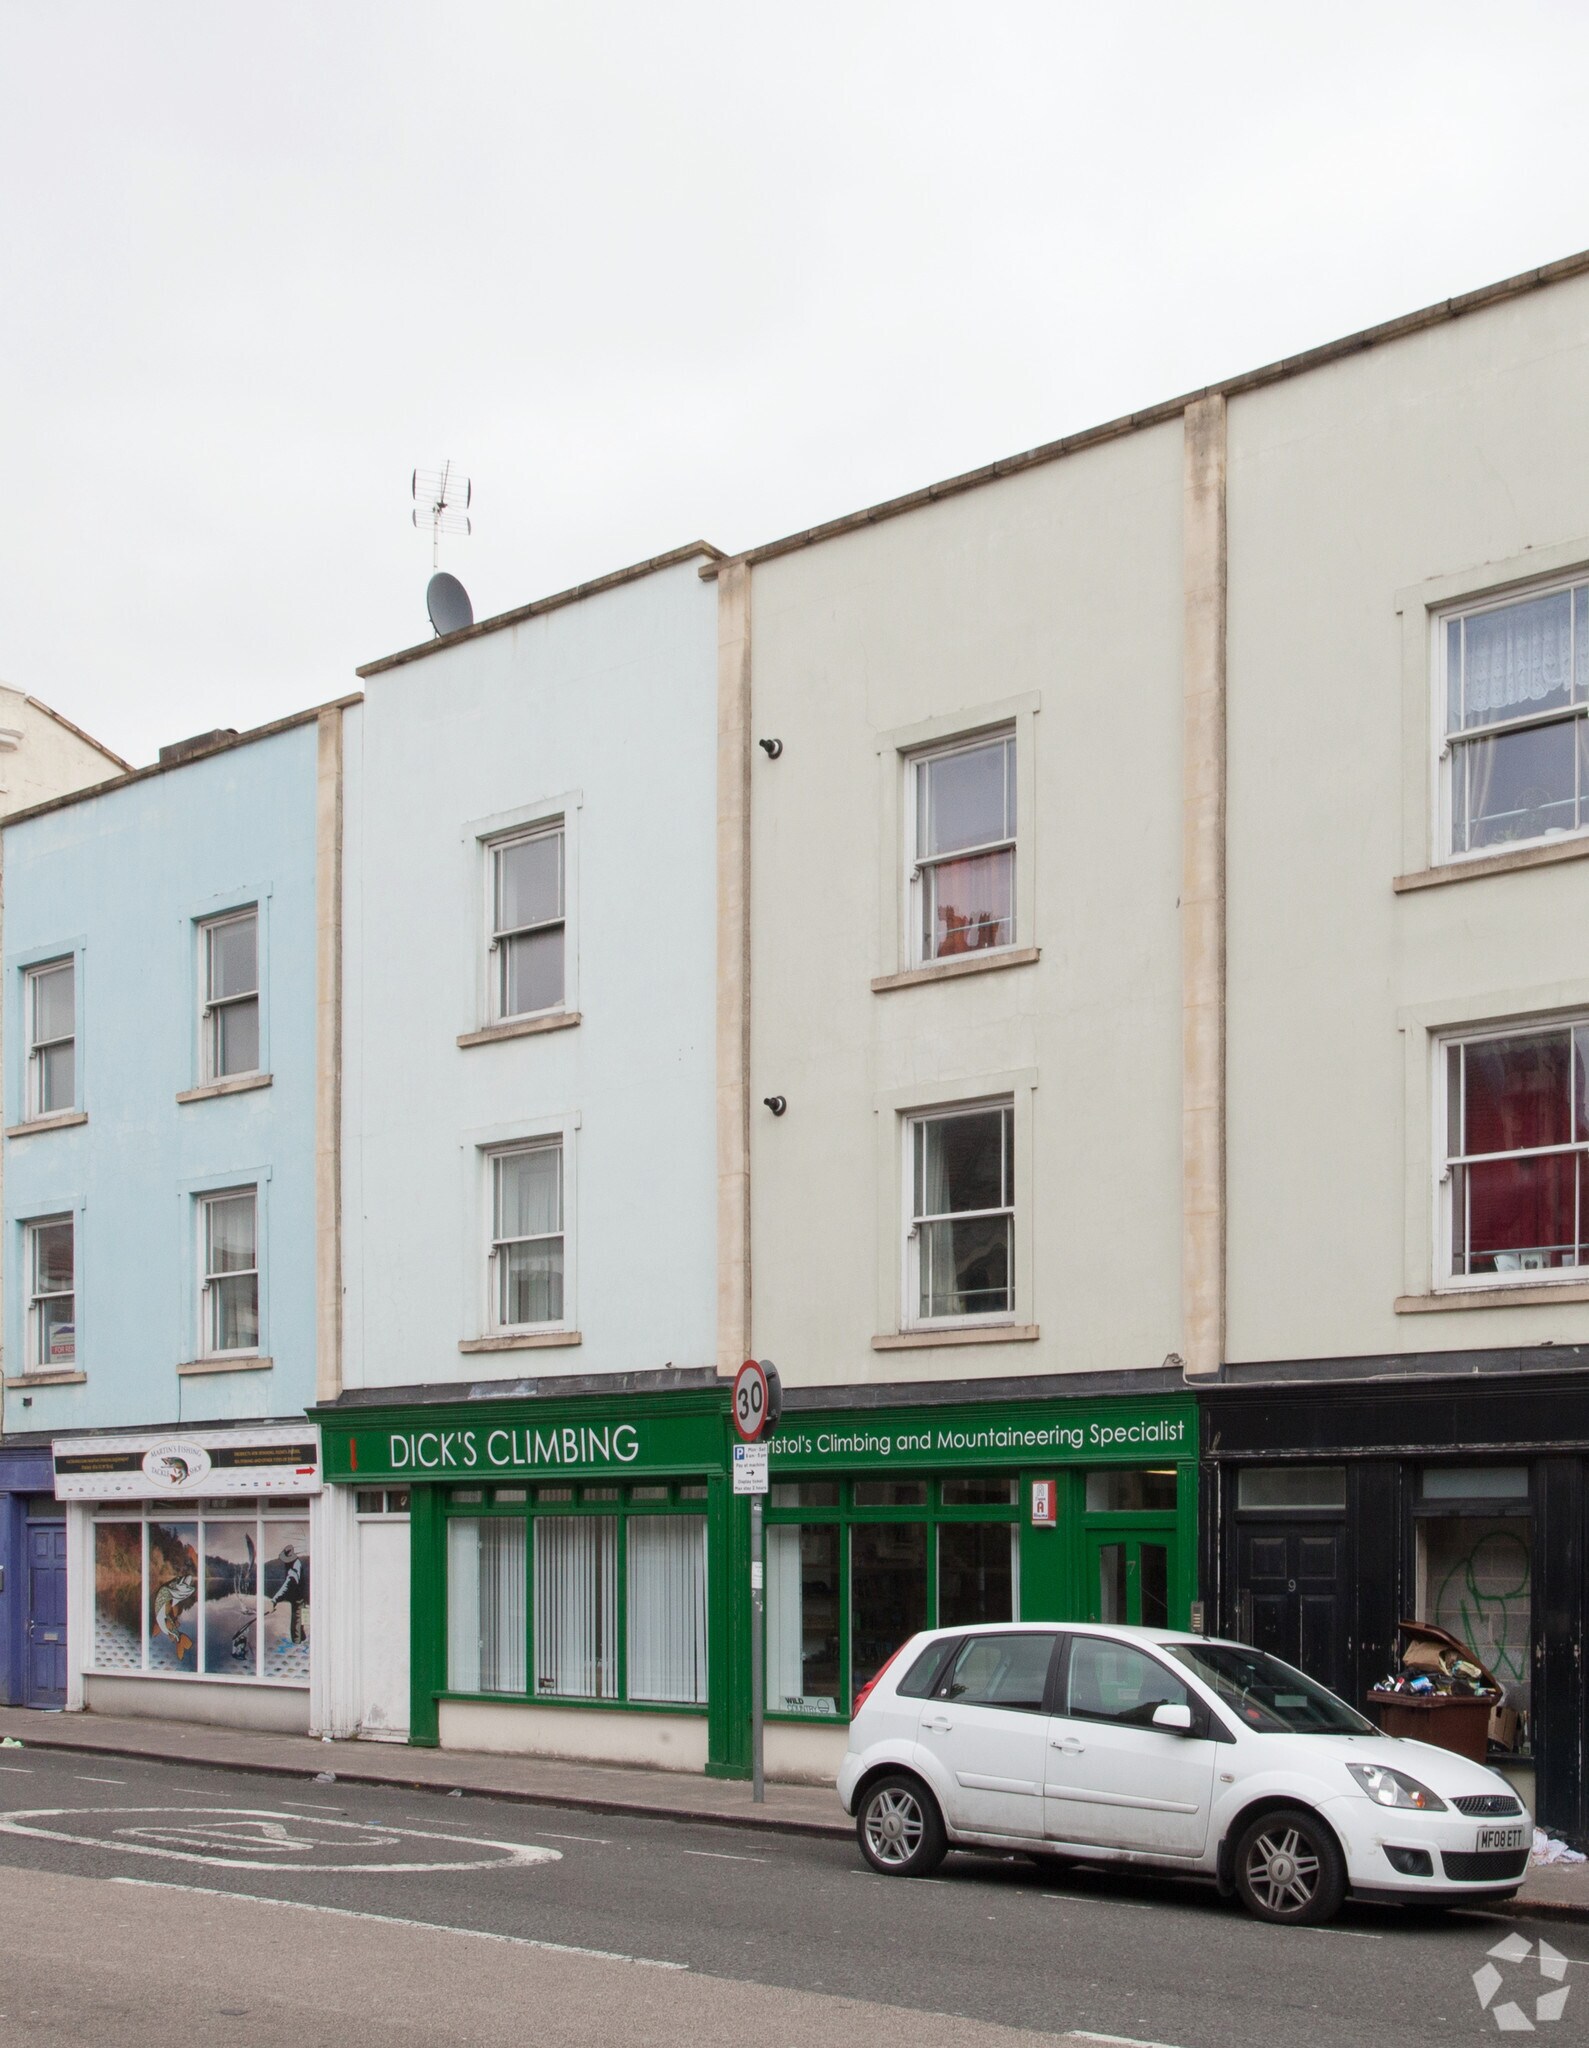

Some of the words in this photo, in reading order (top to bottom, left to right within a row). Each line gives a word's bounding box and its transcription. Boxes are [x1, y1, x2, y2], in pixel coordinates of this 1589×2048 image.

[737, 1380, 763, 1420] 30
[764, 1435, 812, 1454] ristol's
[817, 1432, 891, 1455] Climbing
[897, 1430, 931, 1450] and
[937, 1425, 1084, 1449] Mountaineering
[1089, 1420, 1186, 1447] Specialist
[151, 1445, 176, 1457] MARTIN'S
[178, 1444, 202, 1457] FISHING
[390, 1430, 478, 1468] DICK'S
[487, 1424, 639, 1466] CLIMBING
[736, 1447, 744, 1459] P
[1126, 1560, 1136, 1576] 7
[1287, 1579, 1296, 1593] 9
[785, 1697, 804, 1705] WILD
[1481, 1830, 1505, 1848] MF08
[1507, 1829, 1522, 1847] ETT
